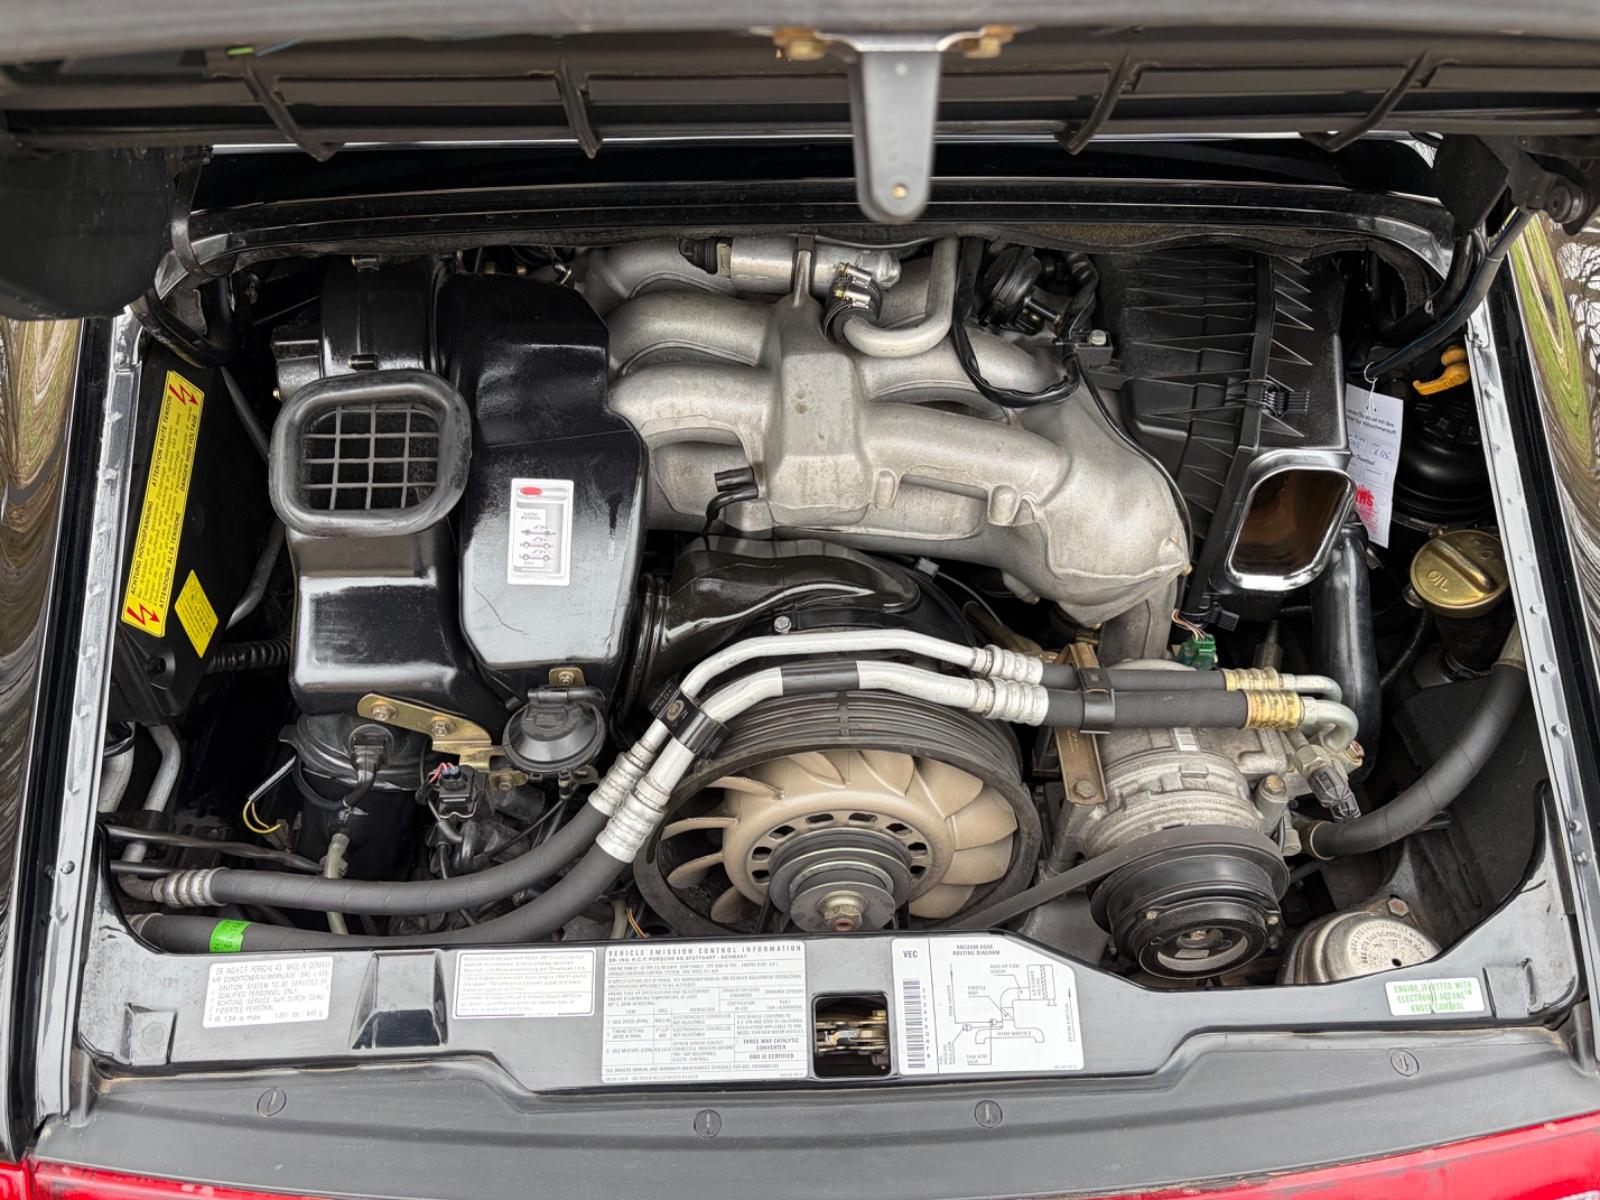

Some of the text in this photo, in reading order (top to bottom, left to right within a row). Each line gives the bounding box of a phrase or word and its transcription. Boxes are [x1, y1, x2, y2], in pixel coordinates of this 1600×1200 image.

[151, 448, 162, 486] ATTENTION
[130, 559, 141, 595] ACHTUNG
[136, 499, 153, 559] HOCHSPANNUNG
[1428, 570, 1449, 593] OIL
[608, 944, 801, 957] VEHICLE EMISSION CONTROL INFORMATION
[251, 964, 272, 973] PORSCHE
[1394, 984, 1418, 993] ENGINE
[1454, 981, 1472, 989] WITH
[218, 991, 246, 999] QUALIFIED
[248, 989, 281, 997] PERSONNEL
[246, 996, 270, 1005] SERVICE
